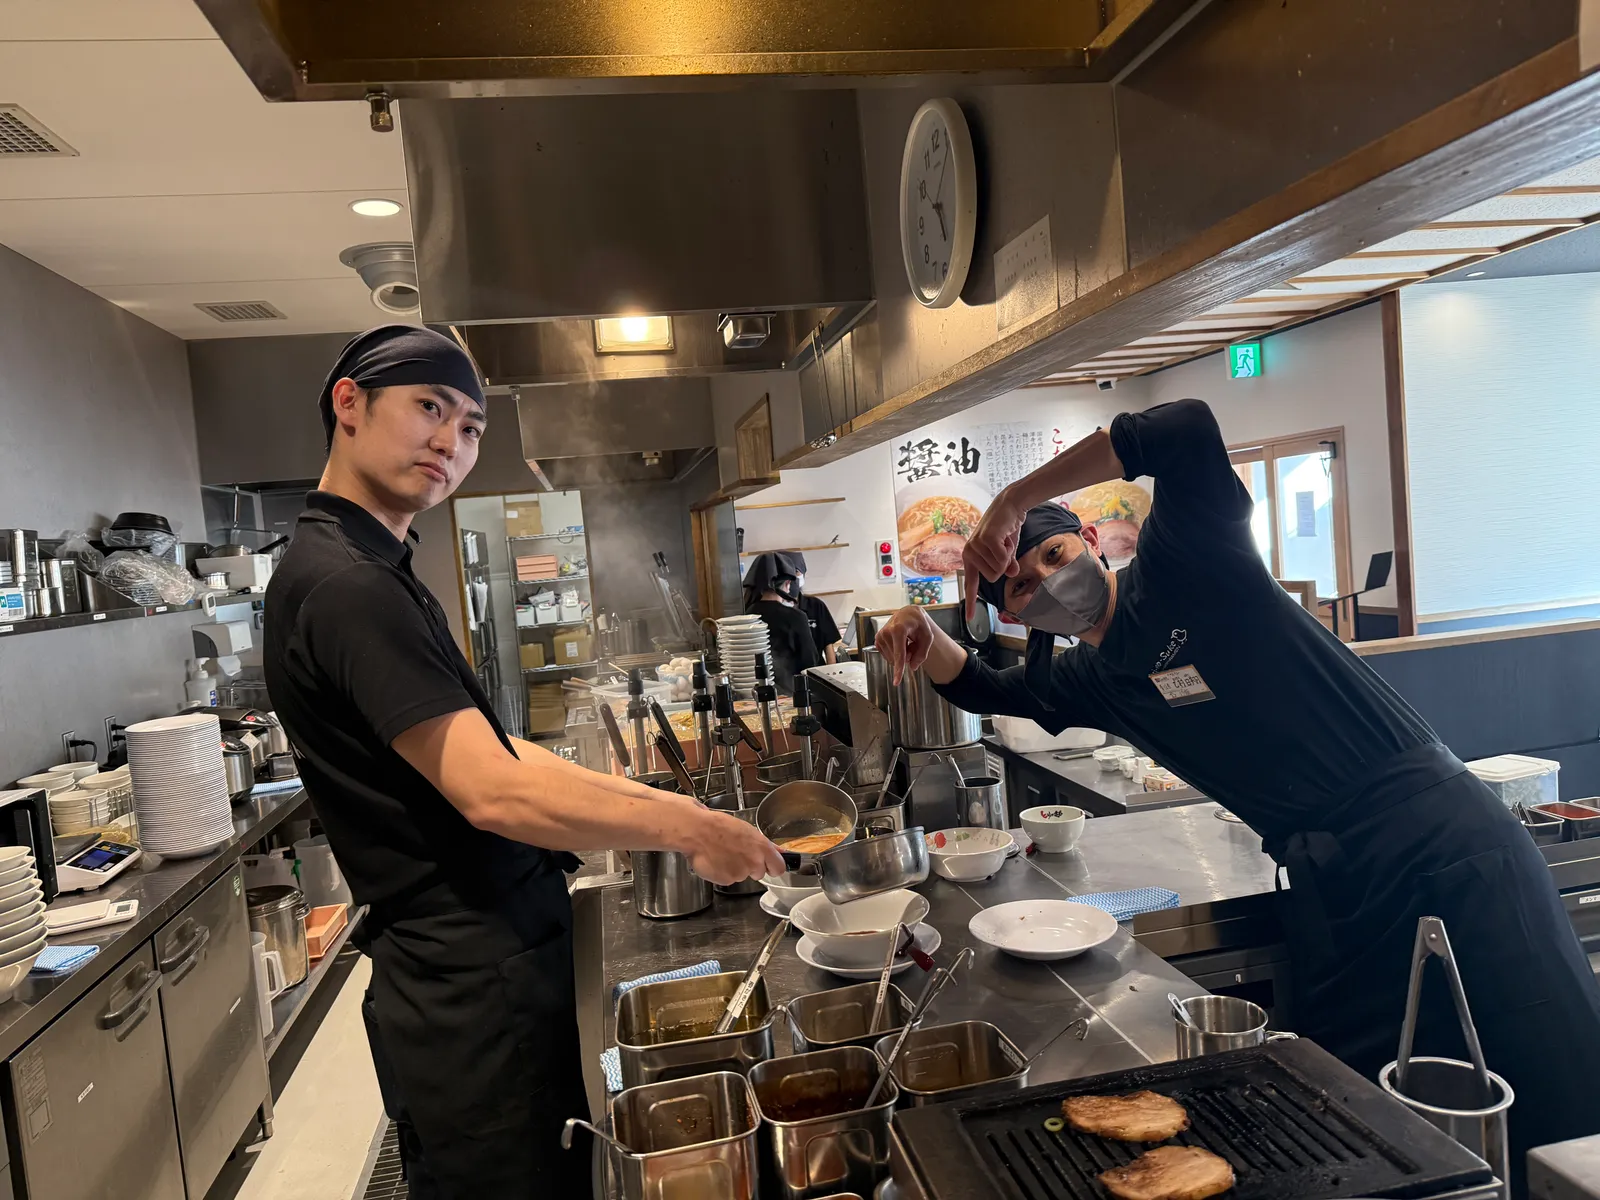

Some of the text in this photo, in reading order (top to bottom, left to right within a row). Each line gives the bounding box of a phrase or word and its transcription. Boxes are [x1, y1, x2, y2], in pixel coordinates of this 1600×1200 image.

[931, 128, 940, 153] 12
[924, 148, 930, 171] 11
[918, 180, 926, 202] 10
[918, 216, 924, 236] 9
[924, 244, 929, 264] 8
[932, 261, 937, 281] 7
